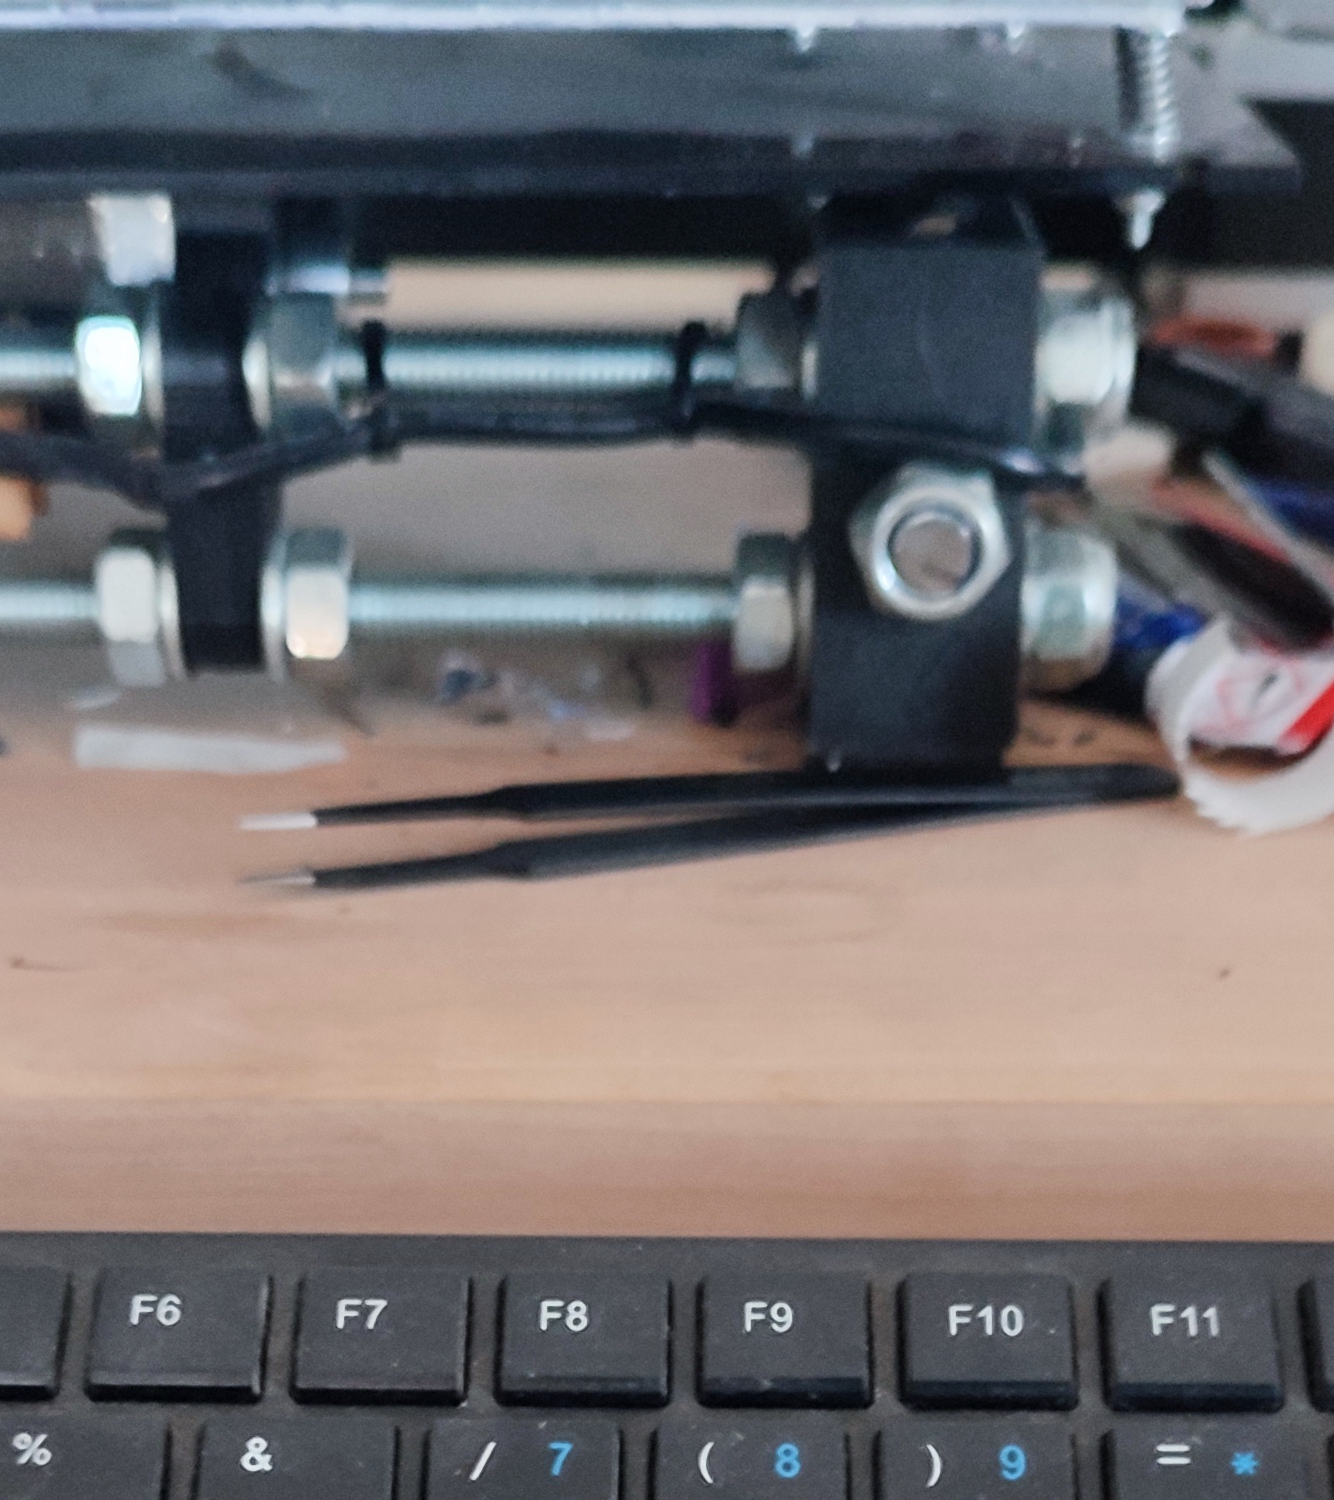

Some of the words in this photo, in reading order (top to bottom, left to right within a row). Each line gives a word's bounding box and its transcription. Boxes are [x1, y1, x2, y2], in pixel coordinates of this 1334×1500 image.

[128, 1293, 183, 1327] F6
[335, 1297, 389, 1331] F7
[538, 1298, 590, 1333] F8
[743, 1299, 795, 1334] F9
[947, 1303, 1025, 1338] F10
[1149, 1302, 1221, 1338] F11
[11, 1431, 53, 1467] %
[239, 1435, 274, 1473] &
[547, 1439, 575, 1477] 7
[773, 1441, 803, 1480] 8
[997, 1442, 1028, 1482] 9
